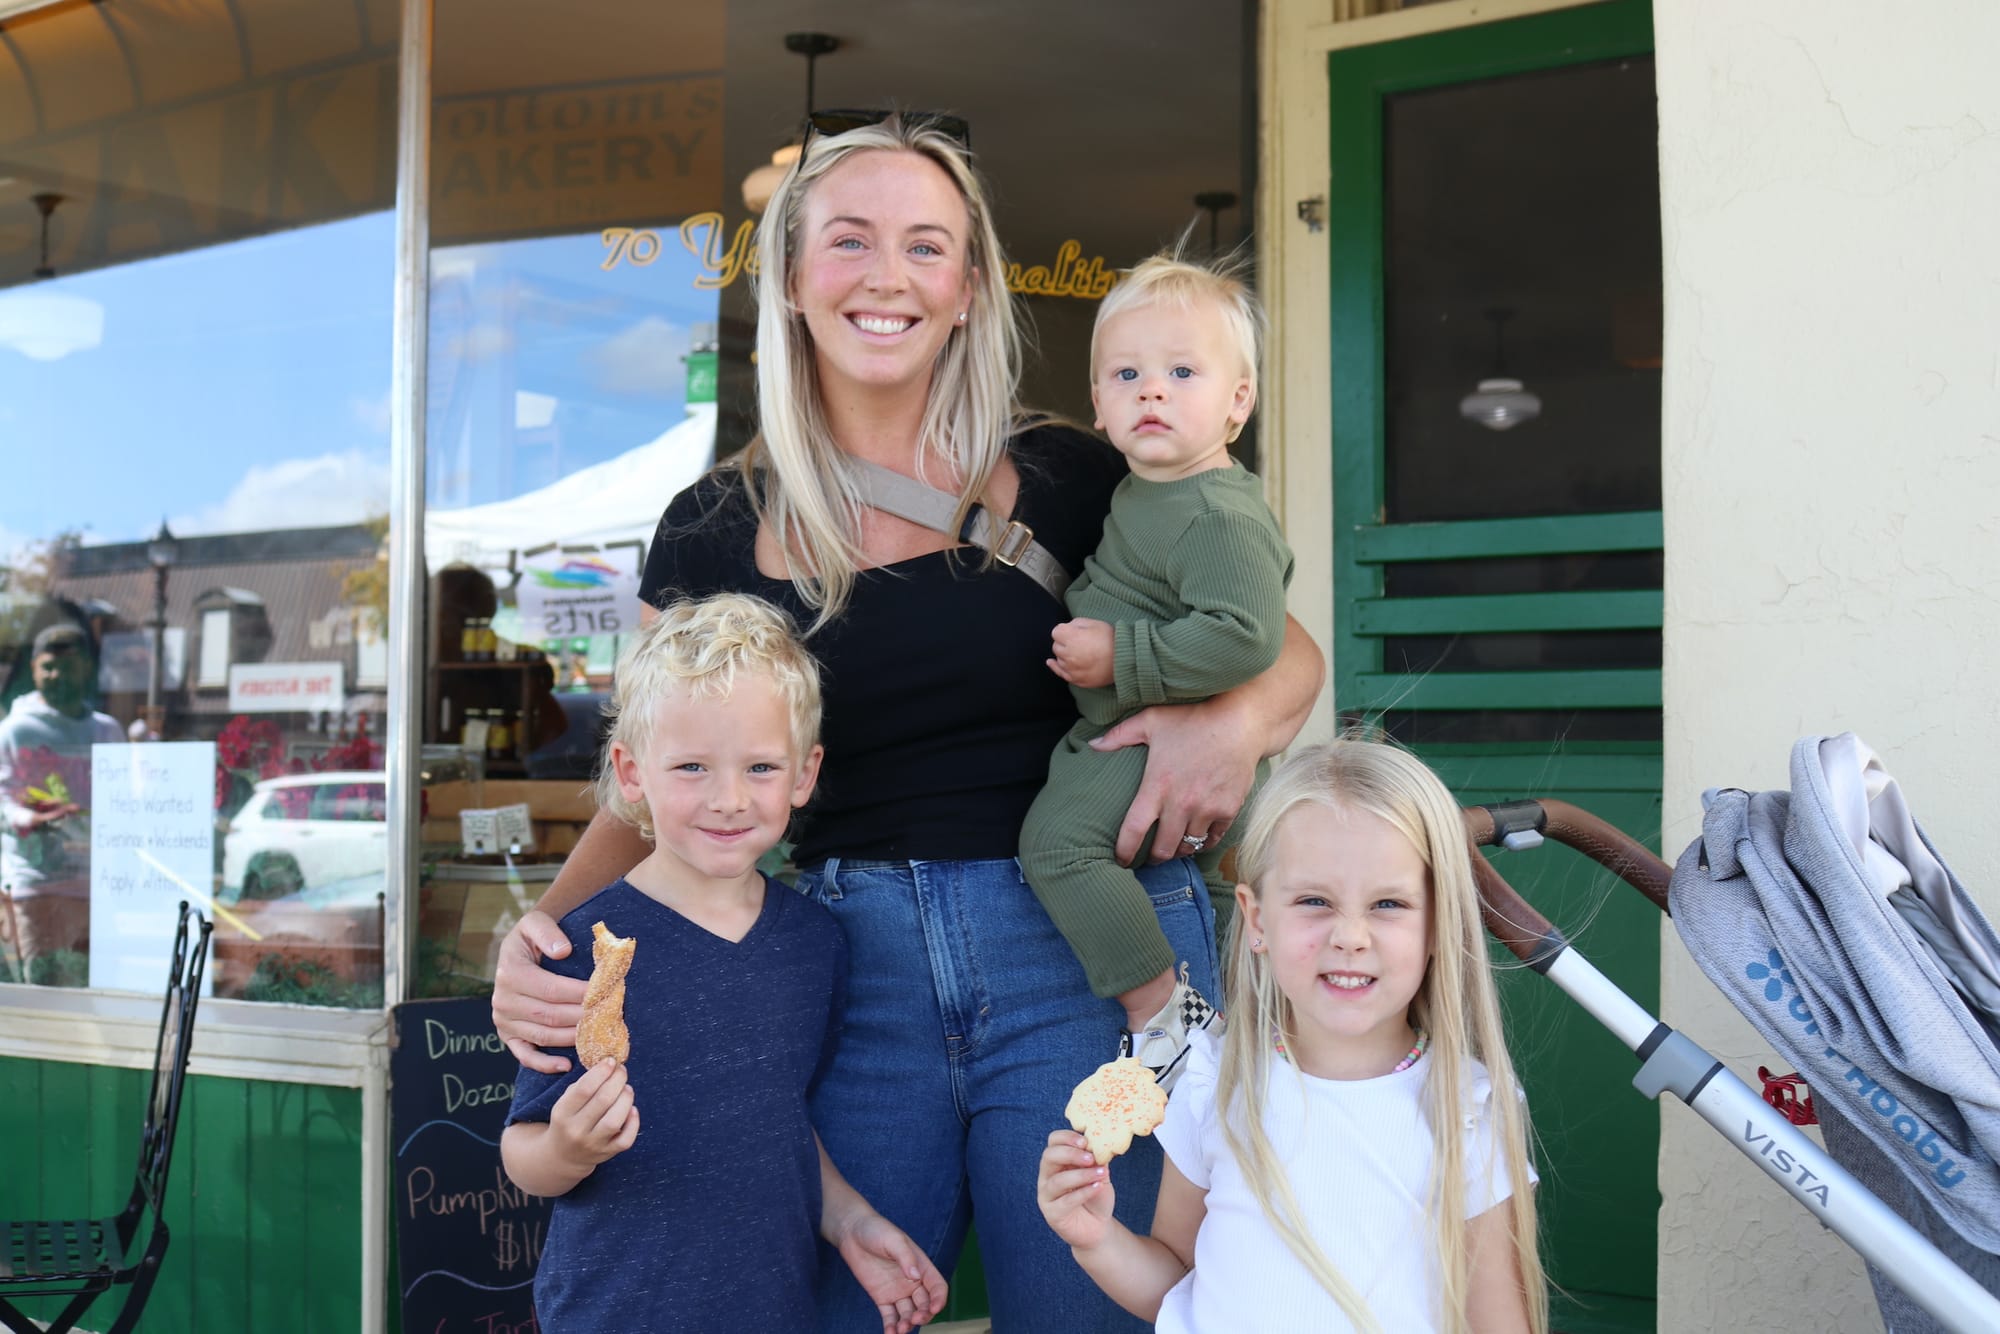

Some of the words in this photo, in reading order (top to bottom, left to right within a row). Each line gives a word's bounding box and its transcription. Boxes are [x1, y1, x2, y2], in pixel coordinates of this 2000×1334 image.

[601, 227, 662, 271] 70
[998, 239, 1131, 299] ualit
[1742, 1119, 1830, 1208] VISTA
